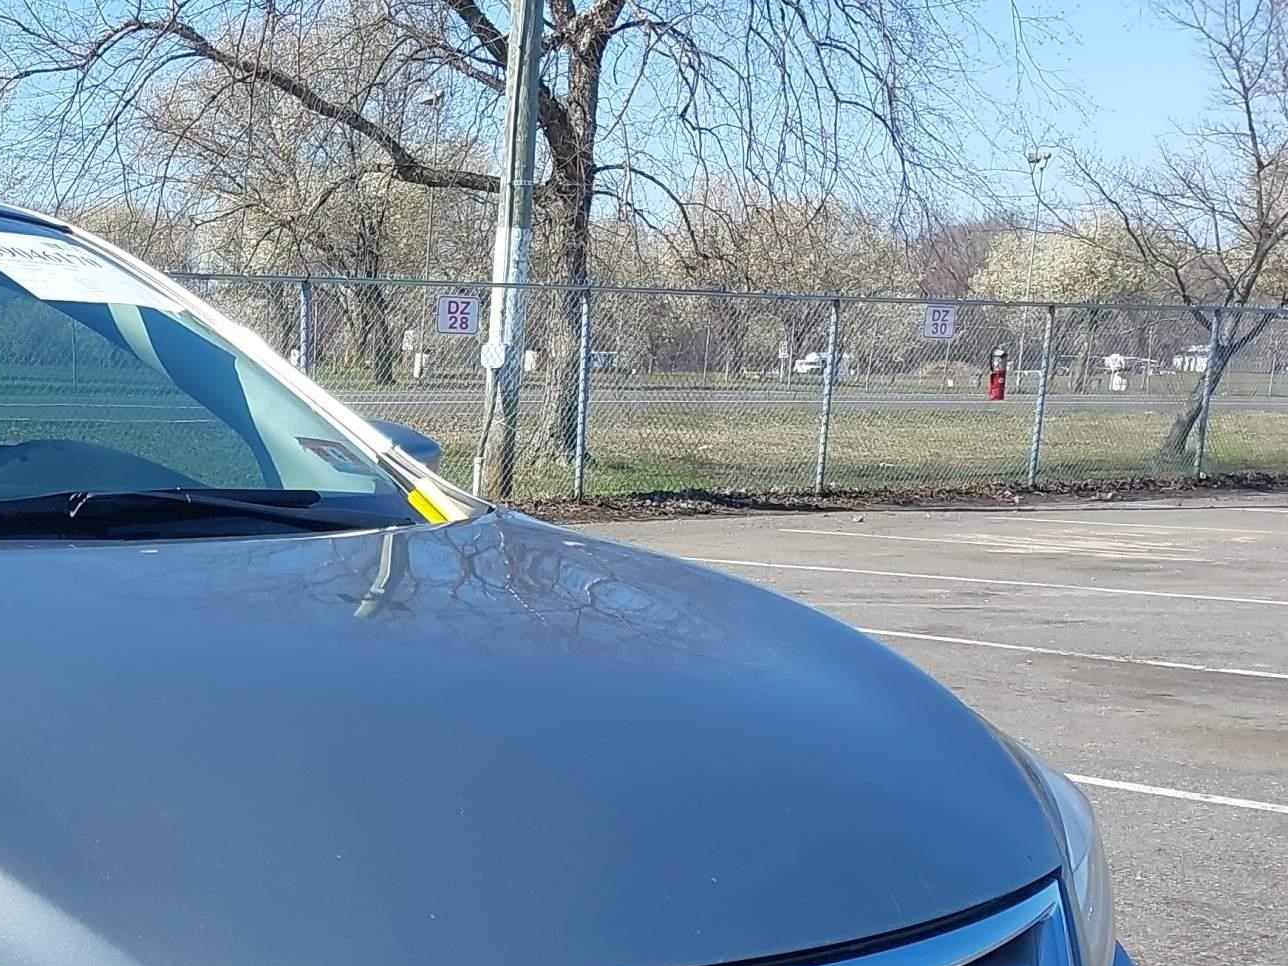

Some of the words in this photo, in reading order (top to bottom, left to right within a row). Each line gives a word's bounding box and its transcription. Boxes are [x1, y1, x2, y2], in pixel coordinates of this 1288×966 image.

[447, 300, 471, 315] DZ
[448, 315, 469, 330] 28
[932, 309, 950, 322] DZ
[932, 322, 947, 335] 30
